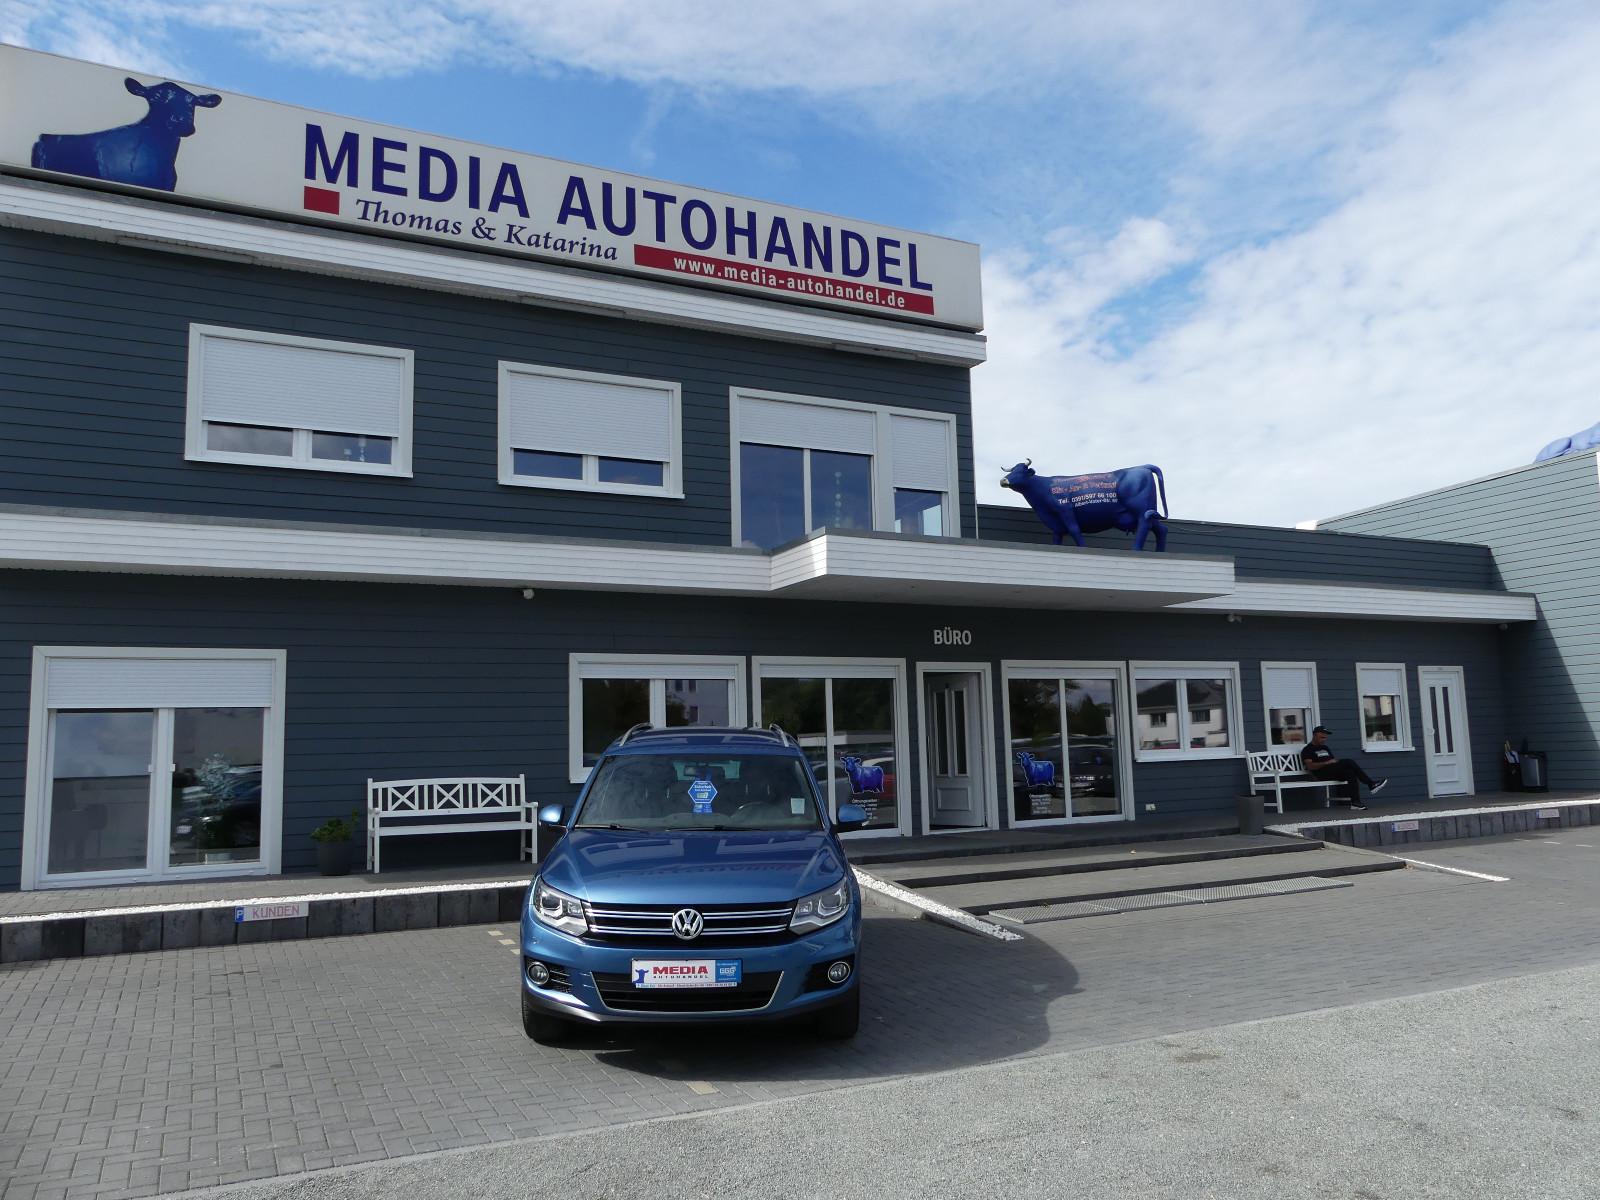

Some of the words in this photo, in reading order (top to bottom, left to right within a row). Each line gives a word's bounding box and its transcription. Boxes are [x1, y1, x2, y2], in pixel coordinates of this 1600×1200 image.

[304, 123, 530, 219] MEDIA
[556, 175, 933, 291] AUTOHANDEL
[356, 199, 462, 235] Thomas
[471, 216, 497, 241] &
[503, 223, 618, 261] Katarina
[673, 255, 905, 308] www.media-autohandel.de
[933, 626, 972, 645] BÜRO
[252, 905, 300, 919] KUNDEN
[652, 966, 709, 975] MEDIA
